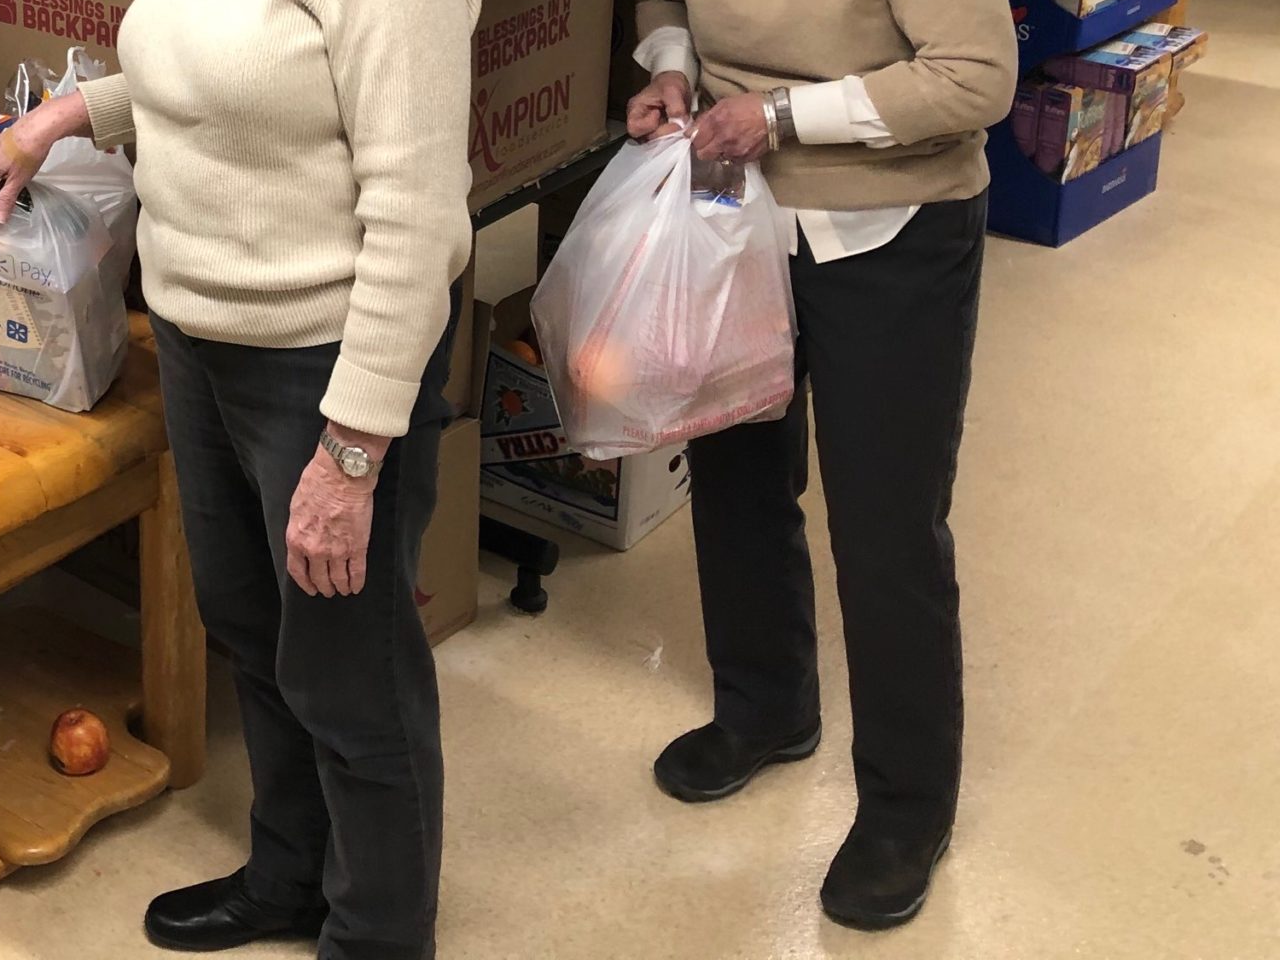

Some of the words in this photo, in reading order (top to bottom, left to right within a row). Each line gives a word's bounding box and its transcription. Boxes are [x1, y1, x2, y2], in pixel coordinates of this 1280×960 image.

[110, 5, 126, 23] IN
[477, 4, 545, 49] BLESSINGS
[477, 11, 570, 78] BACKPACK
[10, 369, 22, 381] FOR
[22, 373, 51, 392] RECYCLING
